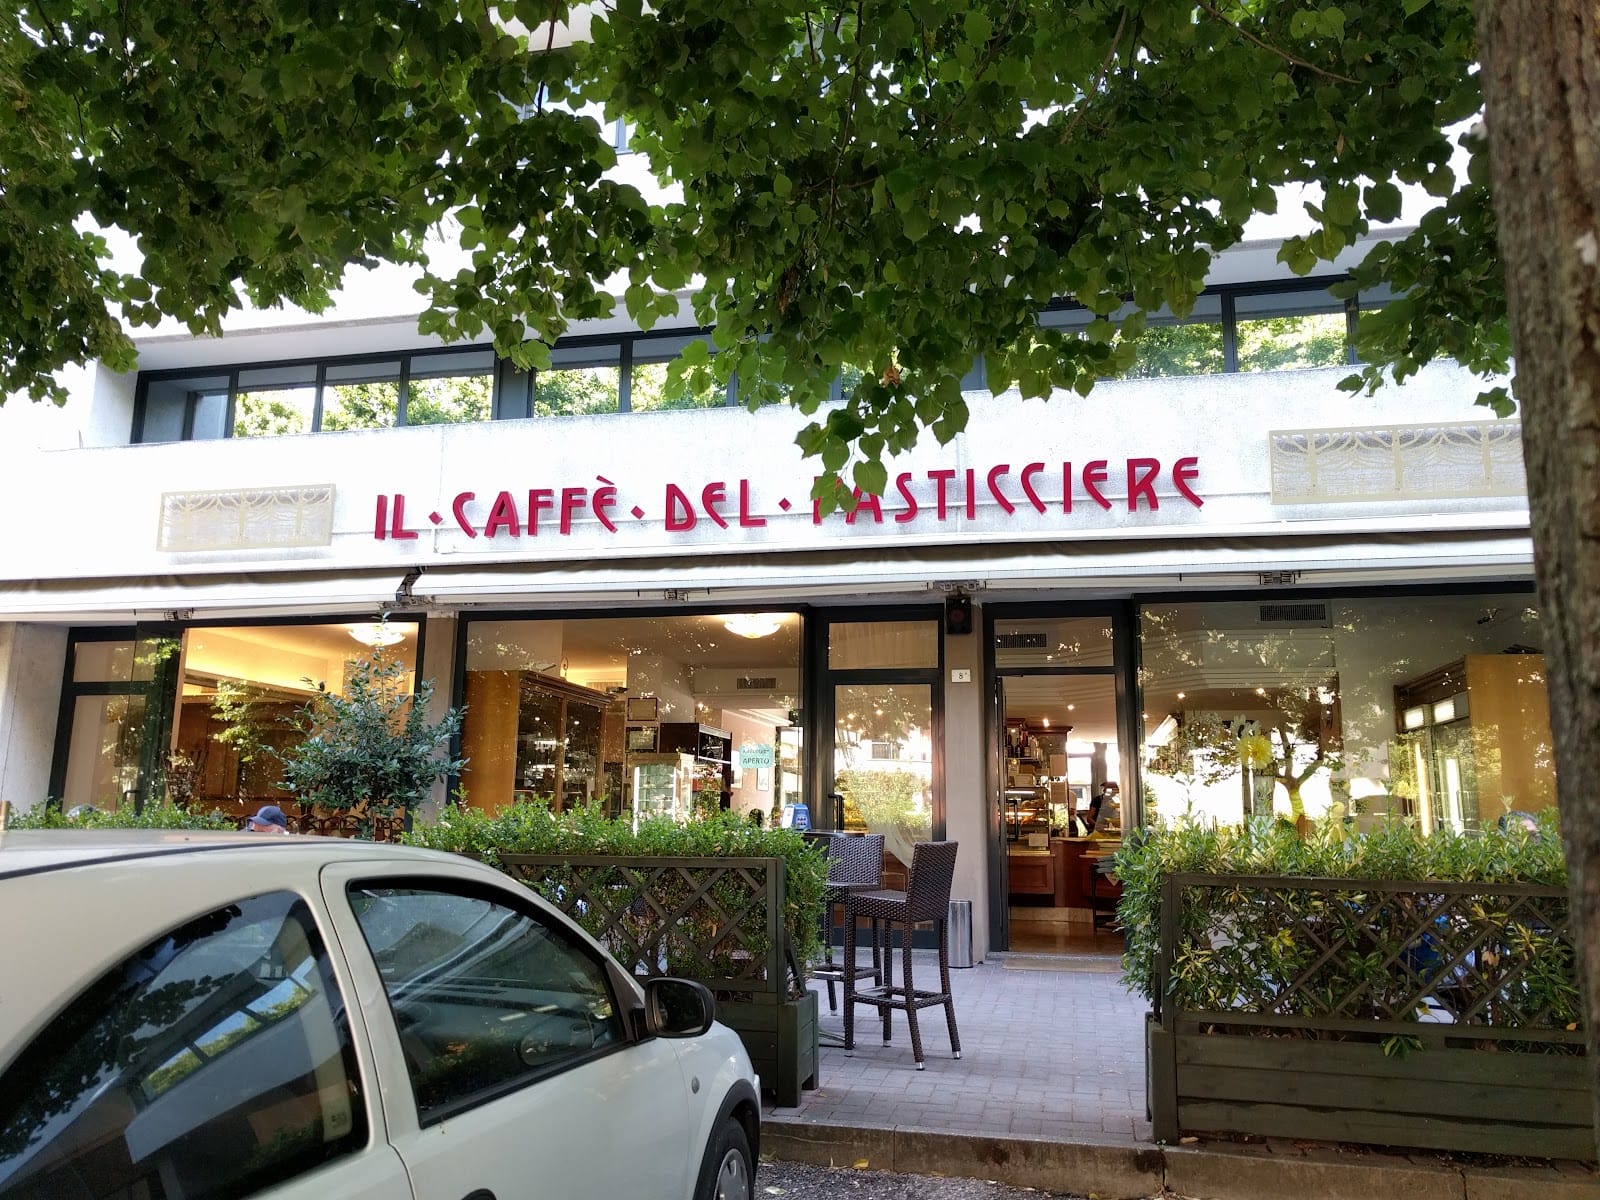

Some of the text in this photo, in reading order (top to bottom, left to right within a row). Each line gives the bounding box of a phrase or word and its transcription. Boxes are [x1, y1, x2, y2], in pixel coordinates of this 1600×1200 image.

[374, 494, 418, 540] IL
[452, 475, 617, 538] CAFFÈ
[665, 479, 767, 532] DEL
